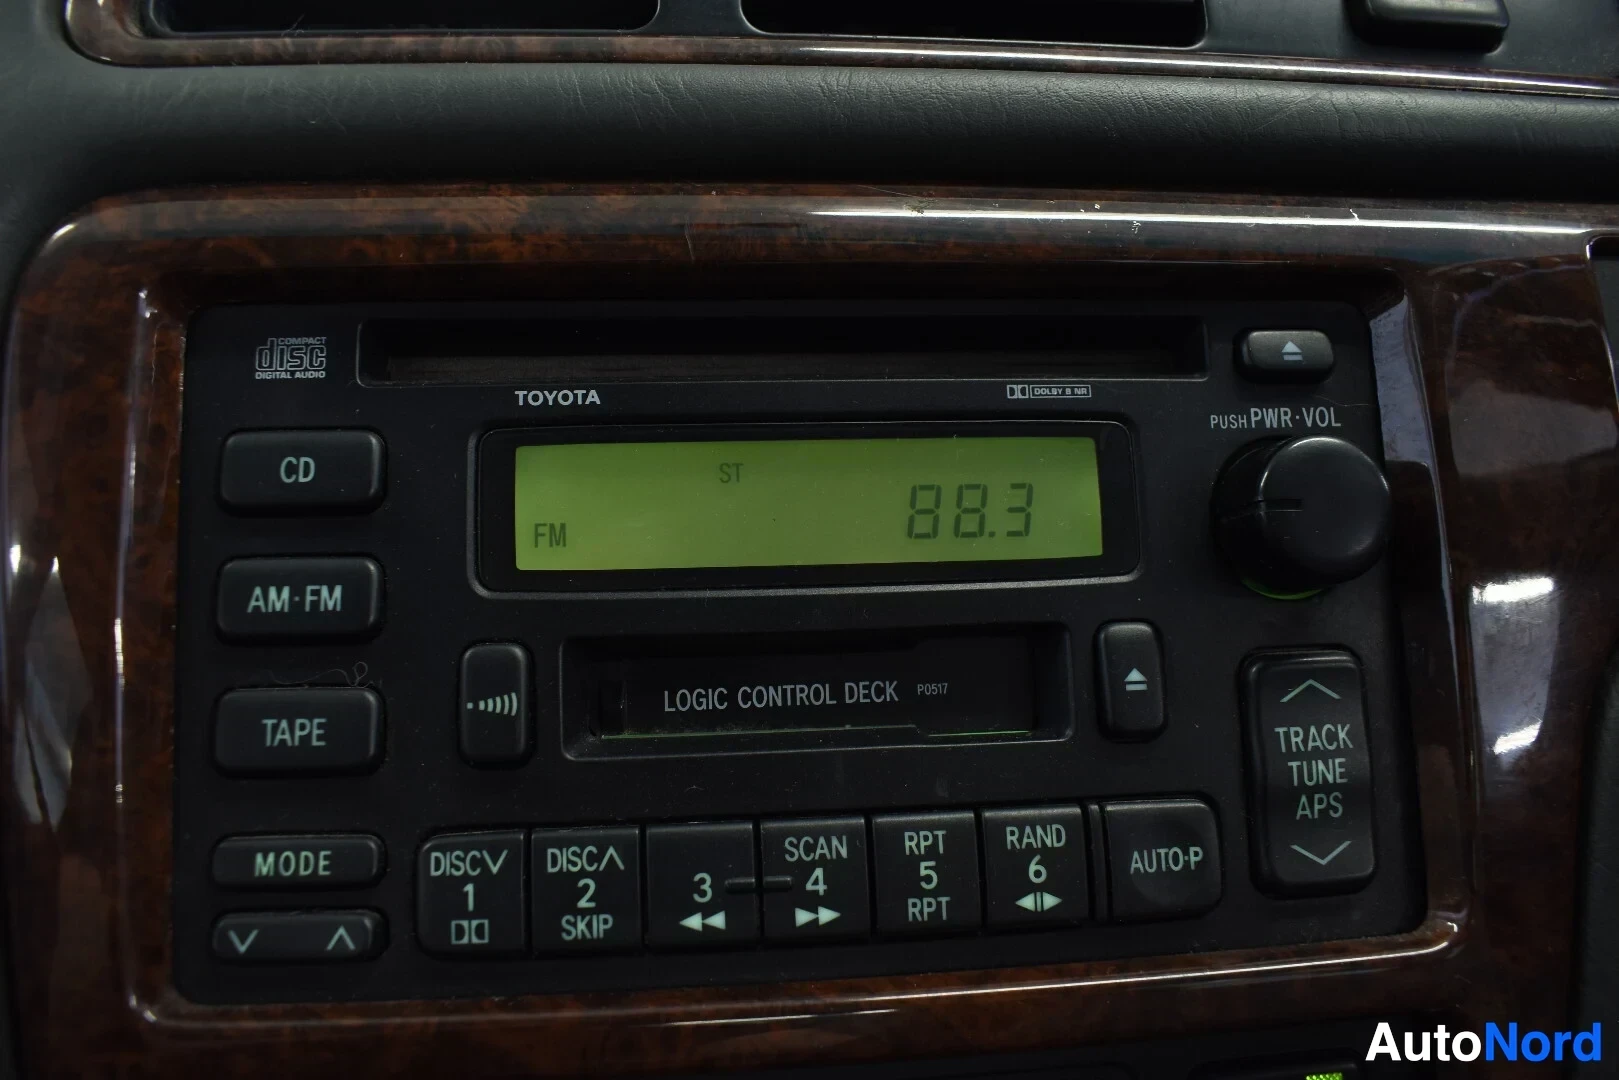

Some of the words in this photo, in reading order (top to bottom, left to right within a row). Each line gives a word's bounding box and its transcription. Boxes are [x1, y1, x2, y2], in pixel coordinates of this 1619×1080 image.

[255, 337, 327, 371] disc
[278, 337, 327, 345] COMPACT
[255, 371, 293, 380] DIGITAL
[294, 371, 326, 379] AUDIO
[515, 390, 600, 406] TOYOTA
[1034, 387, 1063, 395] DOLBY
[1065, 387, 1072, 395] B
[1074, 387, 1087, 395] NR
[1211, 415, 1247, 429] PUSH
[280, 457, 315, 483] CD
[719, 463, 744, 483] ST
[907, 483, 1033, 539] 88.3
[535, 523, 566, 548] FM
[665, 688, 727, 711] LOGIC
[738, 684, 836, 708] CONTROL
[845, 681, 898, 703] DECK
[918, 683, 947, 695] P0517
[262, 719, 326, 746] TAPE
[1275, 724, 1353, 752] TRACK
[1288, 758, 1346, 785] TUNE
[1296, 792, 1342, 819] APS
[785, 836, 847, 861] SCAN
[905, 831, 946, 855] RPT
[1006, 824, 1065, 849] RAND
[256, 851, 331, 876] MODE
[920, 861, 937, 889] 5
[1029, 855, 1046, 883] 6
[577, 879, 595, 907] 2
[694, 873, 712, 902] 3
[806, 868, 827, 895] 4
[464, 884, 473, 911] 1
[908, 897, 950, 921] RPT
[562, 914, 613, 940] SKIP
